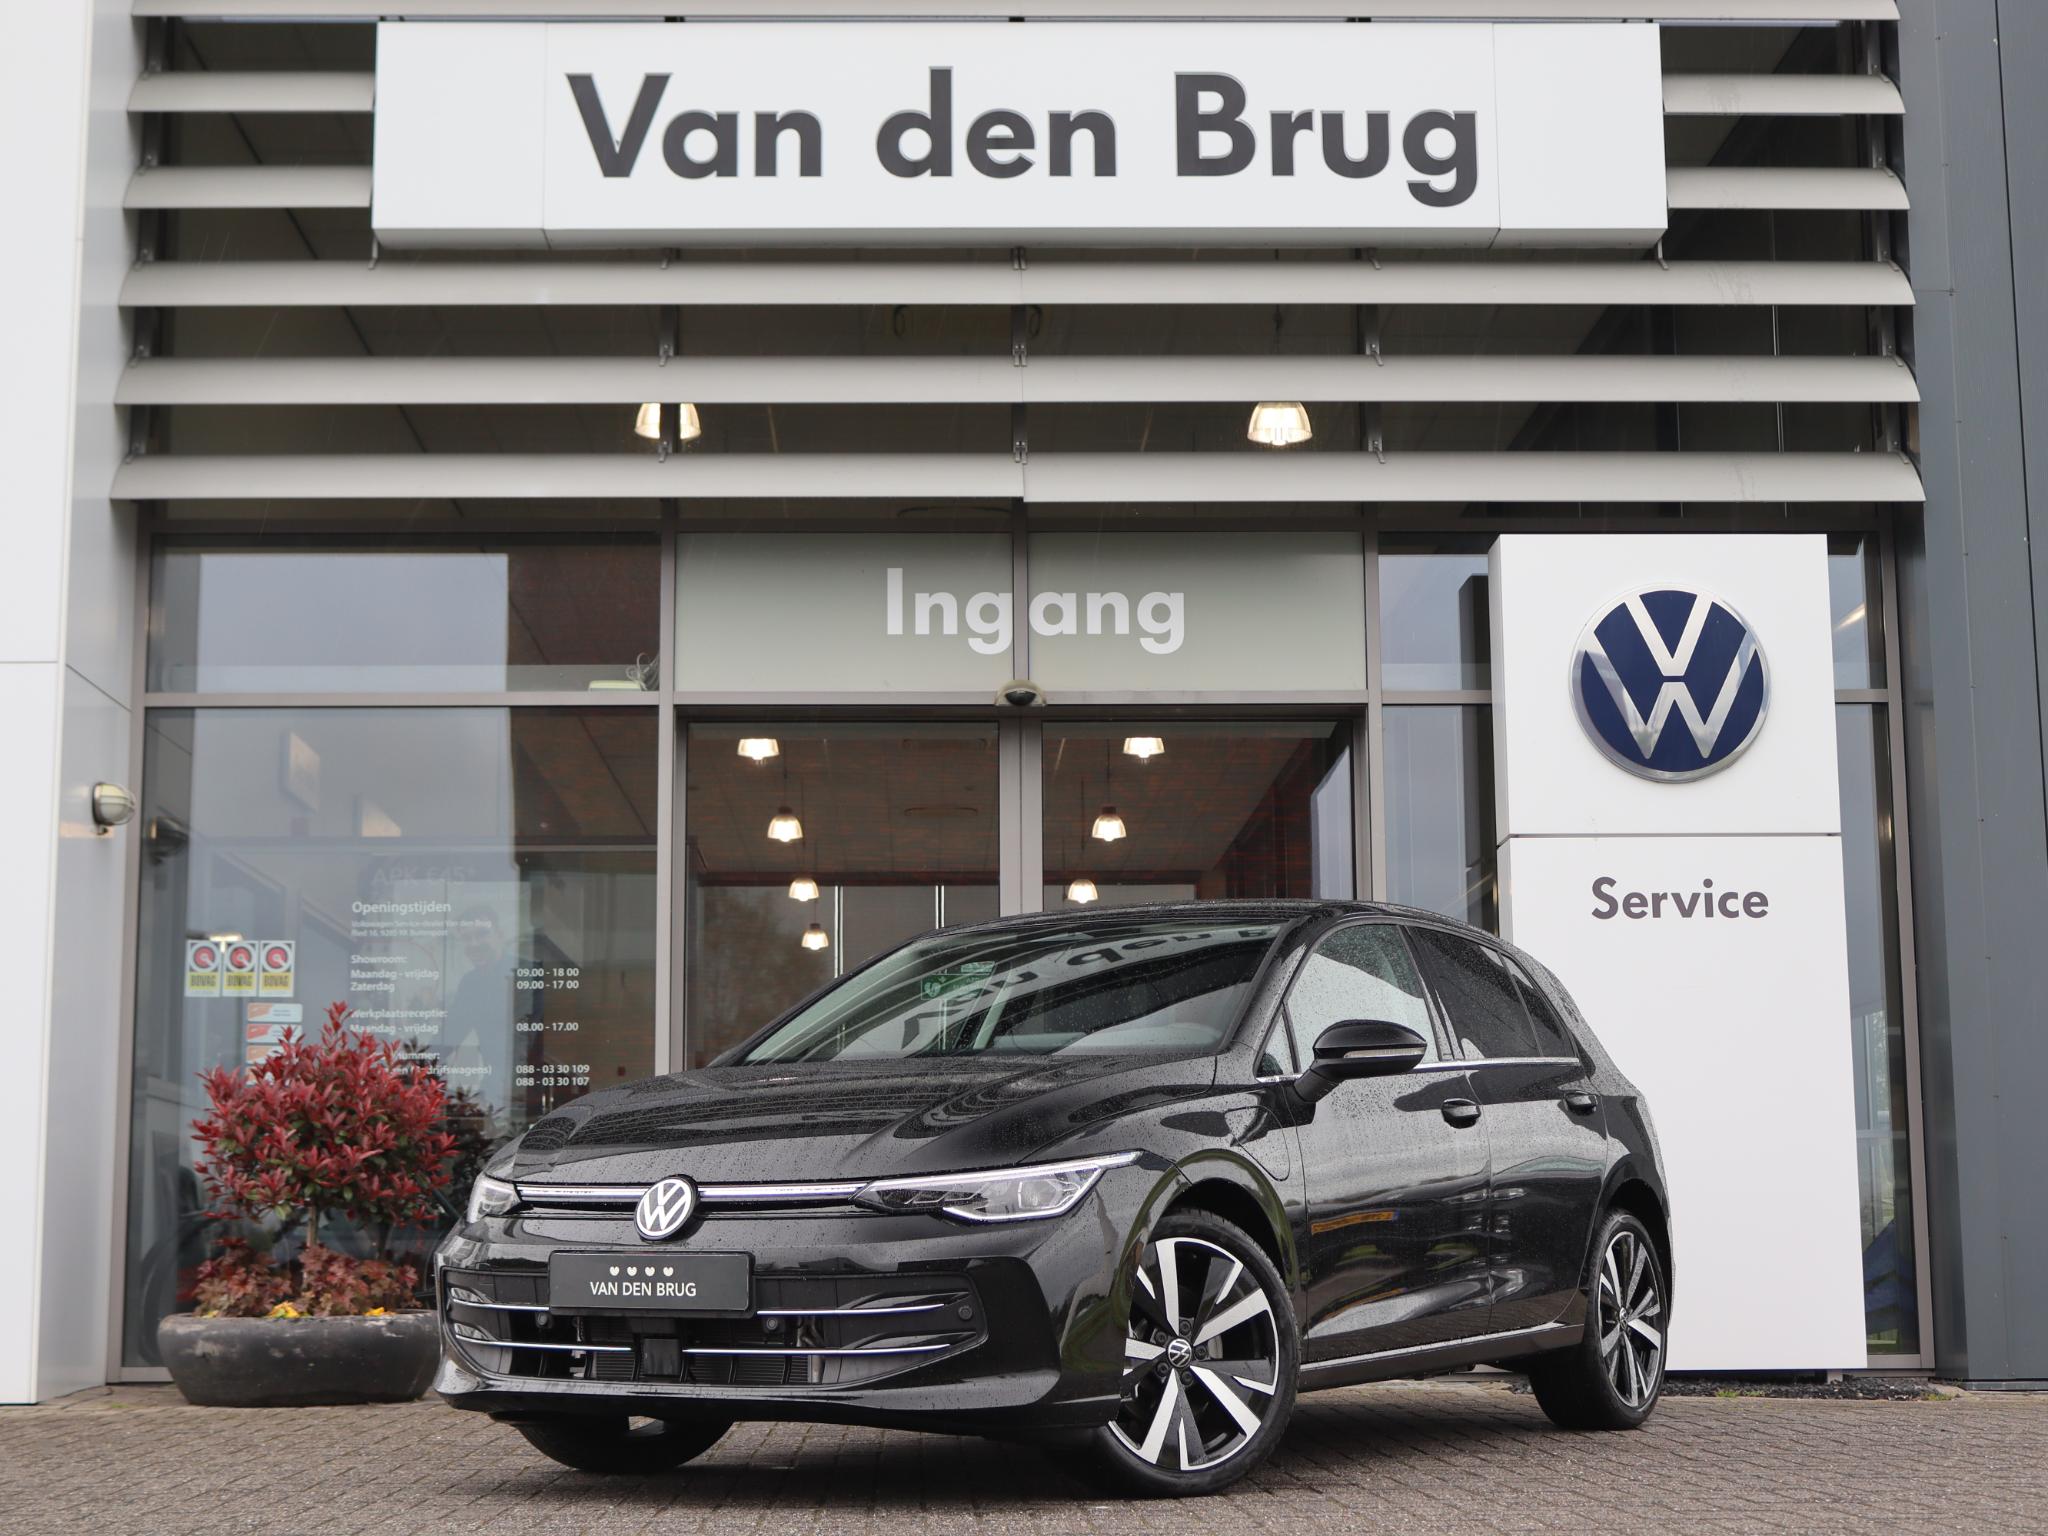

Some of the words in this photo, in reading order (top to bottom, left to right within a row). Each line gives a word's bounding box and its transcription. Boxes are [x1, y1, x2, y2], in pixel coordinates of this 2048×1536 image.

[565, 72, 822, 179] Van
[876, 66, 1117, 179] den
[1174, 71, 1478, 207] Brug
[887, 567, 1184, 654] Ingang
[1591, 876, 1769, 920] Service
[352, 901, 451, 915] Openingstijden
[351, 954, 408, 964] Showroom:
[351, 969, 398, 981] Maandag
[404, 968, 440, 981] vrijdag
[517, 968, 544, 977] 09.00
[350, 981, 395, 993] Zaterdag
[517, 981, 544, 989] 09.00
[404, 1022, 438, 1035] vrijdag
[516, 1022, 543, 1031] 08.00
[552, 1022, 579, 1031] 17.00
[516, 1065, 535, 1073] 088
[542, 1064, 554, 1073] 03
[556, 1064, 569, 1073] 30
[572, 1064, 590, 1073] 109
[516, 1077, 534, 1086] 088
[542, 1077, 554, 1086] 03
[556, 1077, 569, 1086] 30
[572, 1077, 590, 1085] 107
[590, 1281, 618, 1296] VAN
[622, 1281, 652, 1296] DEN
[656, 1282, 697, 1297] BRUG
